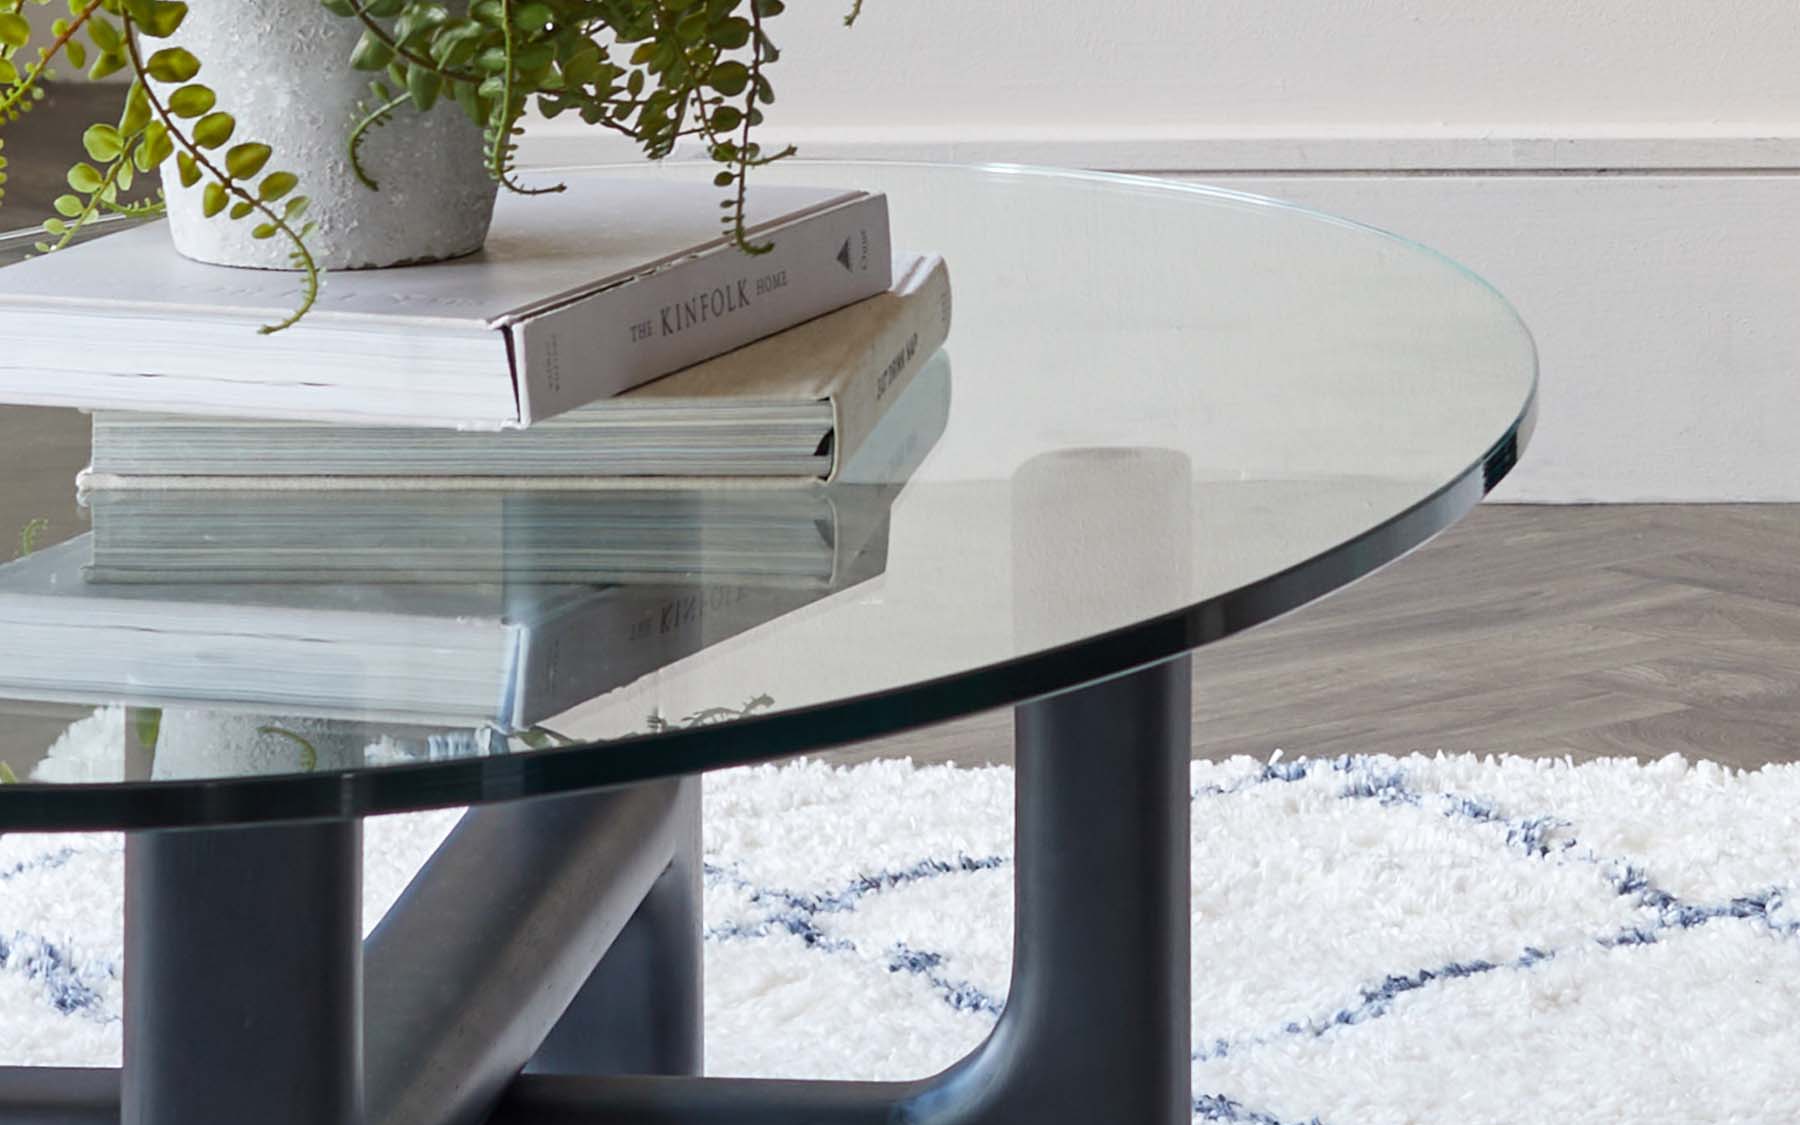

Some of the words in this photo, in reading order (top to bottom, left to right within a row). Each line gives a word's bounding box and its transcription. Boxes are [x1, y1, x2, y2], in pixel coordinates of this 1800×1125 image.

[630, 320, 652, 342] THE
[660, 277, 750, 337] KINFOLK
[756, 270, 788, 296] HOME
